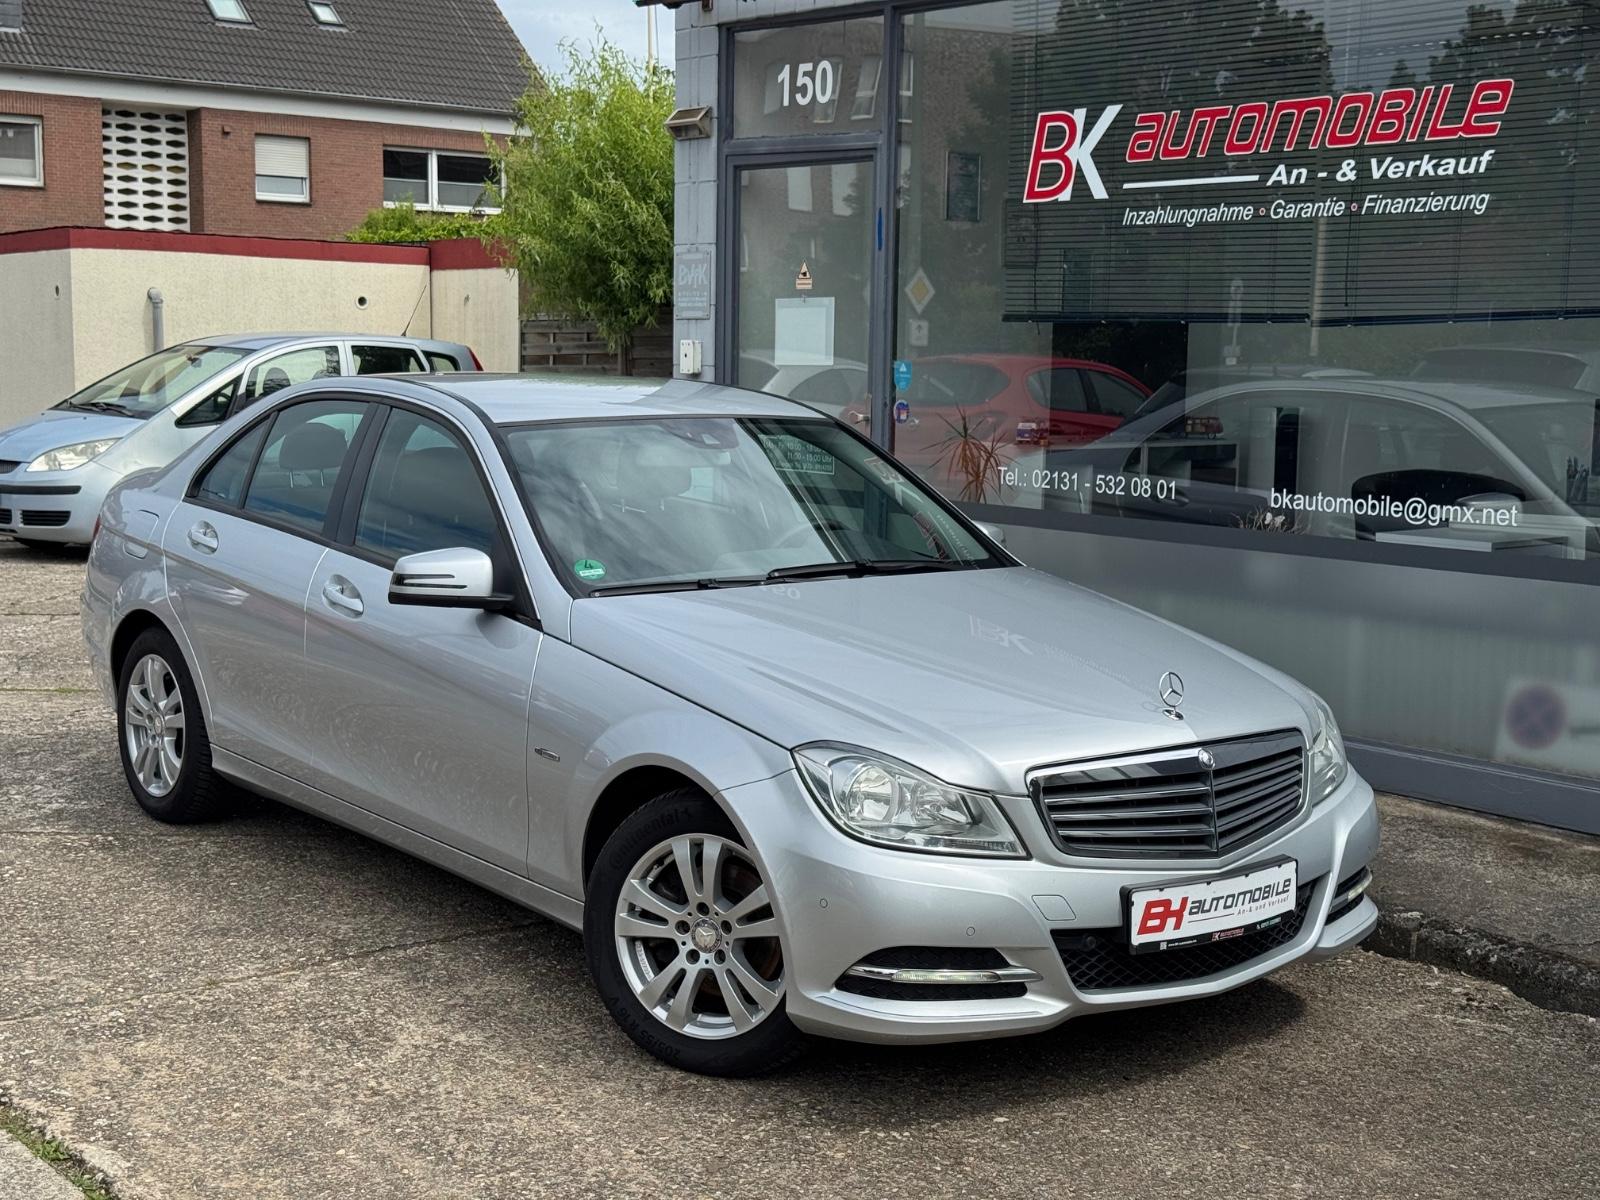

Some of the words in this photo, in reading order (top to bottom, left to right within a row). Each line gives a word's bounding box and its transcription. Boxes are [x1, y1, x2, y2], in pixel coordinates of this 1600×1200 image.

[777, 60, 833, 107] 150
[1023, 104, 1123, 204] BK
[1266, 164, 1308, 186] An
[1335, 159, 1357, 182] &
[1370, 150, 1495, 180] Verkauf
[1122, 203, 1254, 228] Inzahlungnahme
[1270, 197, 1345, 219] Garantie
[1361, 191, 1490, 216] Finanzierung
[998, 467, 1027, 487] Tel.:
[1032, 469, 1078, 491] 02131
[1095, 475, 1126, 495] 532
[1130, 477, 1151, 497] 08
[1156, 479, 1176, 500] 01
[1270, 488, 1518, 527] bkautomobile@gmx.net
[1137, 896, 1189, 935] BK
